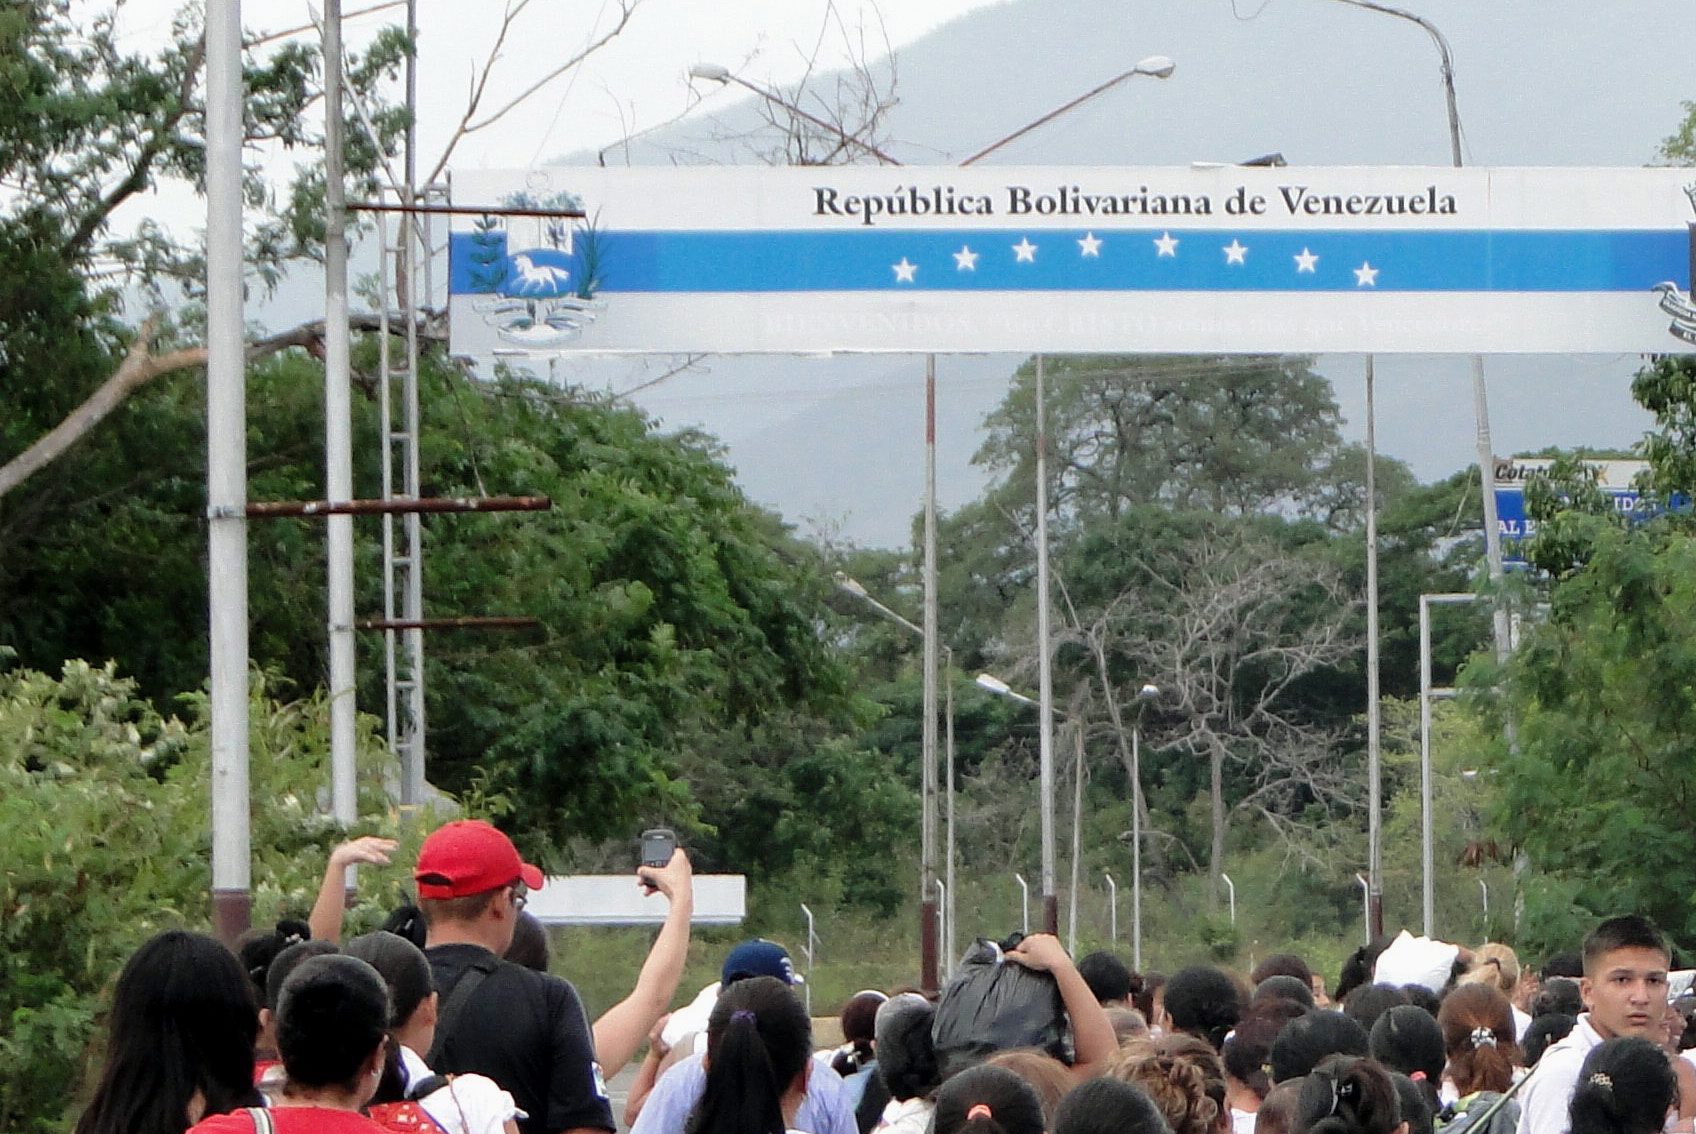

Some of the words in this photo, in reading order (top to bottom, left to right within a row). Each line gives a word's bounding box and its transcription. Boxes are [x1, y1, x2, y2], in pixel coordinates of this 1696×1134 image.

[813, 185, 993, 226] República
[1005, 185, 1212, 219] Bolivariana
[1225, 186, 1267, 217] de
[1280, 187, 1458, 217] Venezuela
